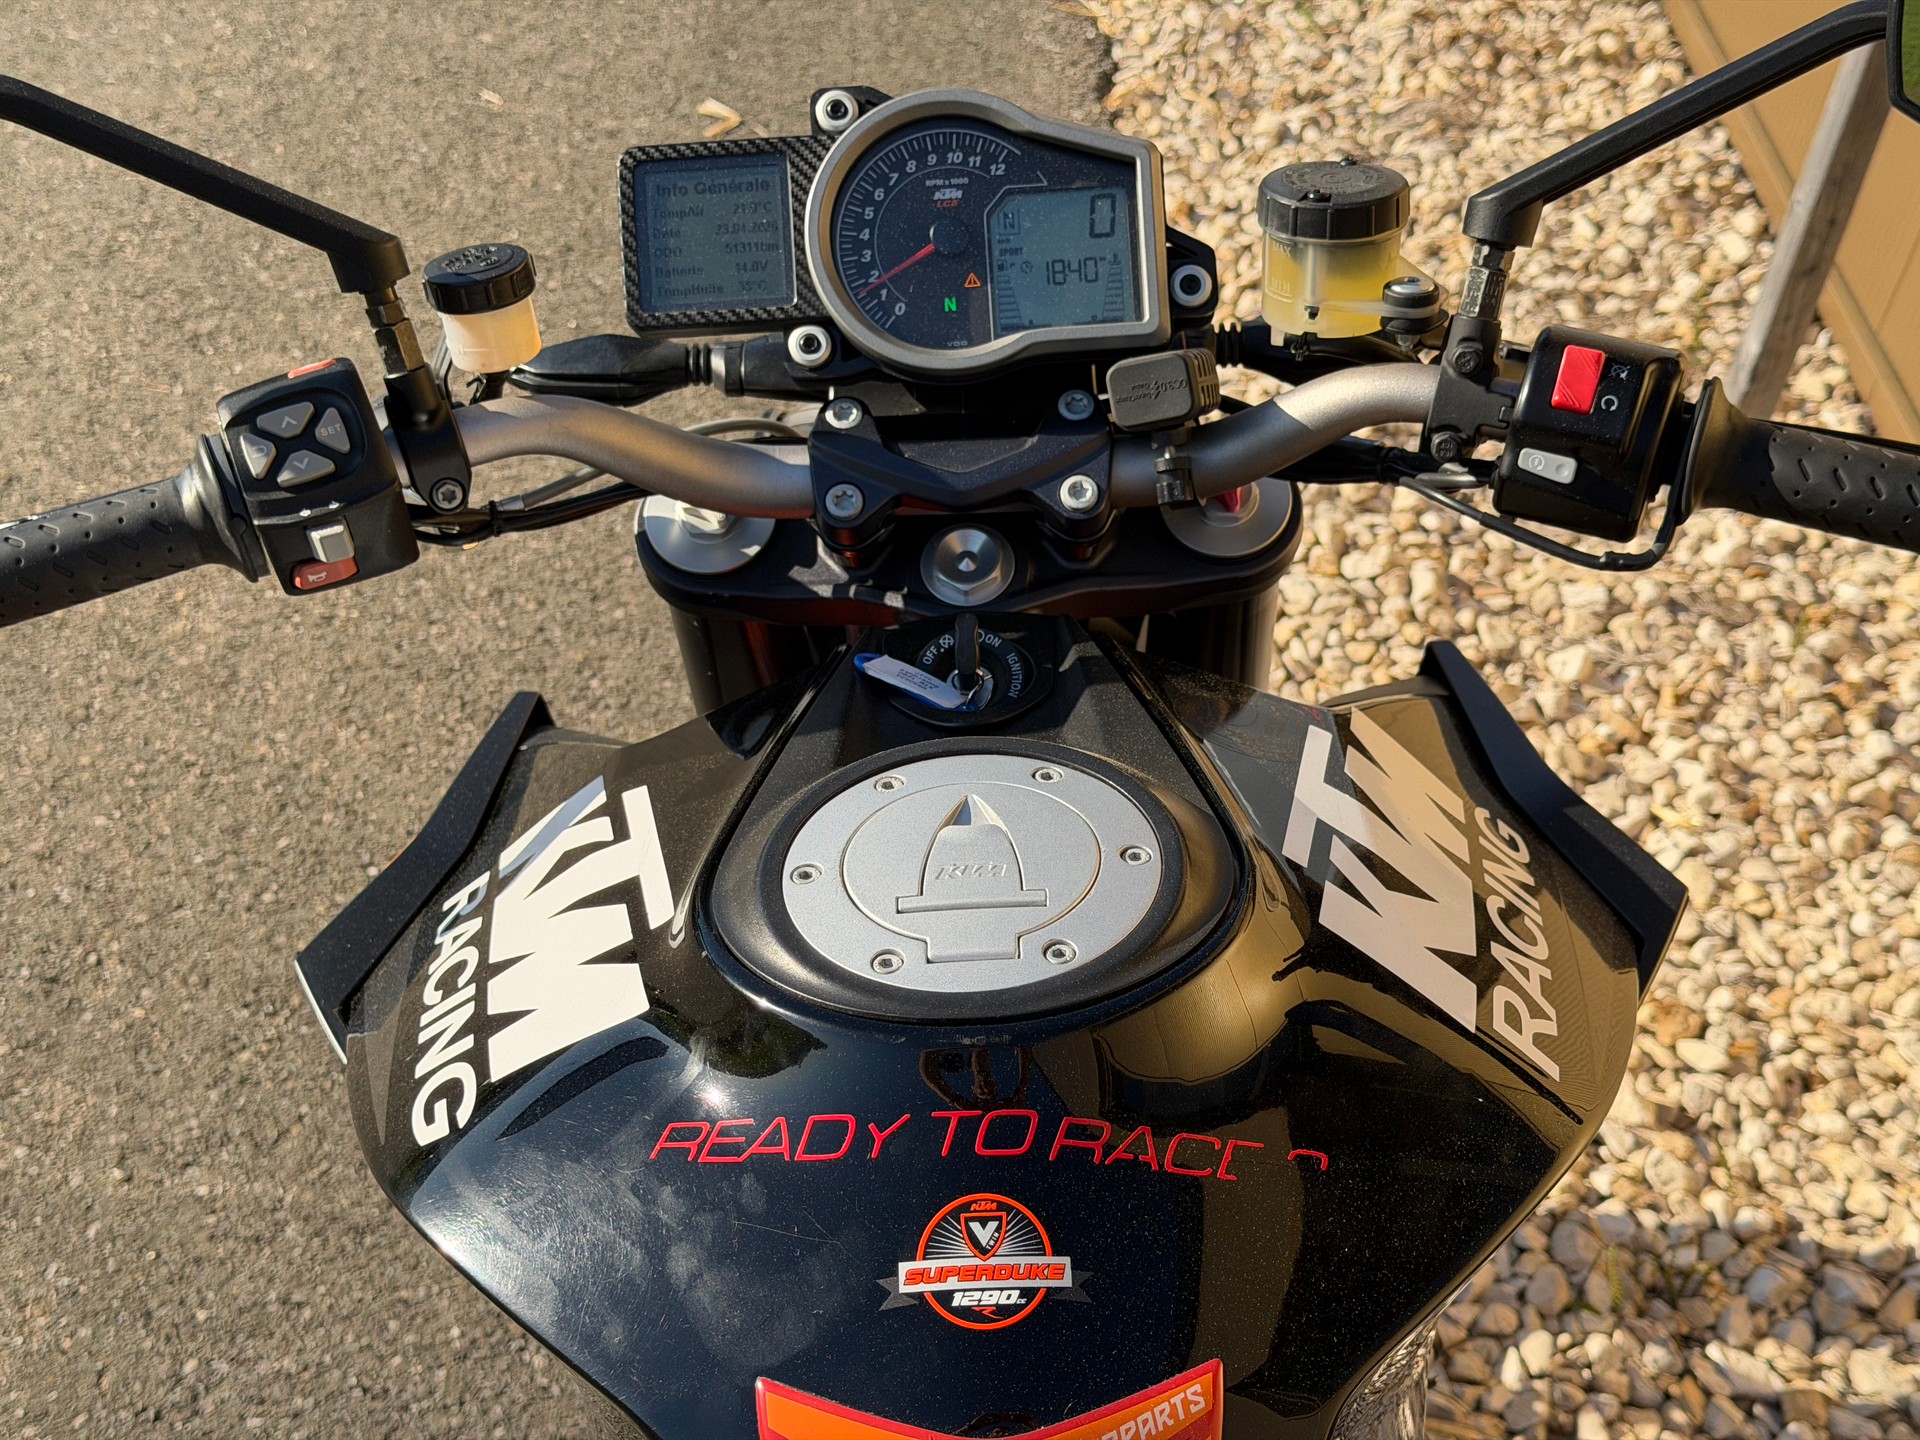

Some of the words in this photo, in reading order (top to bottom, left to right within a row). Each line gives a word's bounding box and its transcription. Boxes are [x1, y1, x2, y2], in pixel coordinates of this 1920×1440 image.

[927, 154, 937, 165] 9
[947, 152, 963, 164] 10
[968, 156, 981, 167] 11
[906, 160, 916, 173] 8
[990, 164, 1006, 176] 12
[889, 173, 899, 186] 7
[926, 179, 943, 187] RPM
[950, 177, 969, 185] 1000
[656, 183, 688, 197] Info
[874, 188, 885, 201] 6
[934, 188, 963, 200] KTM
[864, 207, 875, 220] 5
[859, 228, 870, 241] 4
[861, 250, 872, 262] 3
[1000, 247, 1024, 257] SPORT
[868, 270, 879, 283] 2
[880, 289, 888, 301] 1
[895, 302, 906, 316] 0
[944, 297, 957, 312] N
[320, 423, 342, 437] SET
[985, 633, 1002, 648] ON
[922, 645, 938, 665] OFF
[1005, 652, 1024, 698] IGNITION
[1281, 706, 1477, 1034] KTM
[487, 774, 675, 1083] KTM
[1474, 806, 1560, 1082] RACING
[411, 870, 491, 1147] RACING
[650, 1112, 911, 1164] READY
[931, 1109, 1039, 1157] TO
[970, 1200, 997, 1211] KTM
[968, 1220, 1000, 1248] V
[986, 1231, 1000, 1250] TWIN
[903, 1263, 1066, 1286] SUPERDUKE
